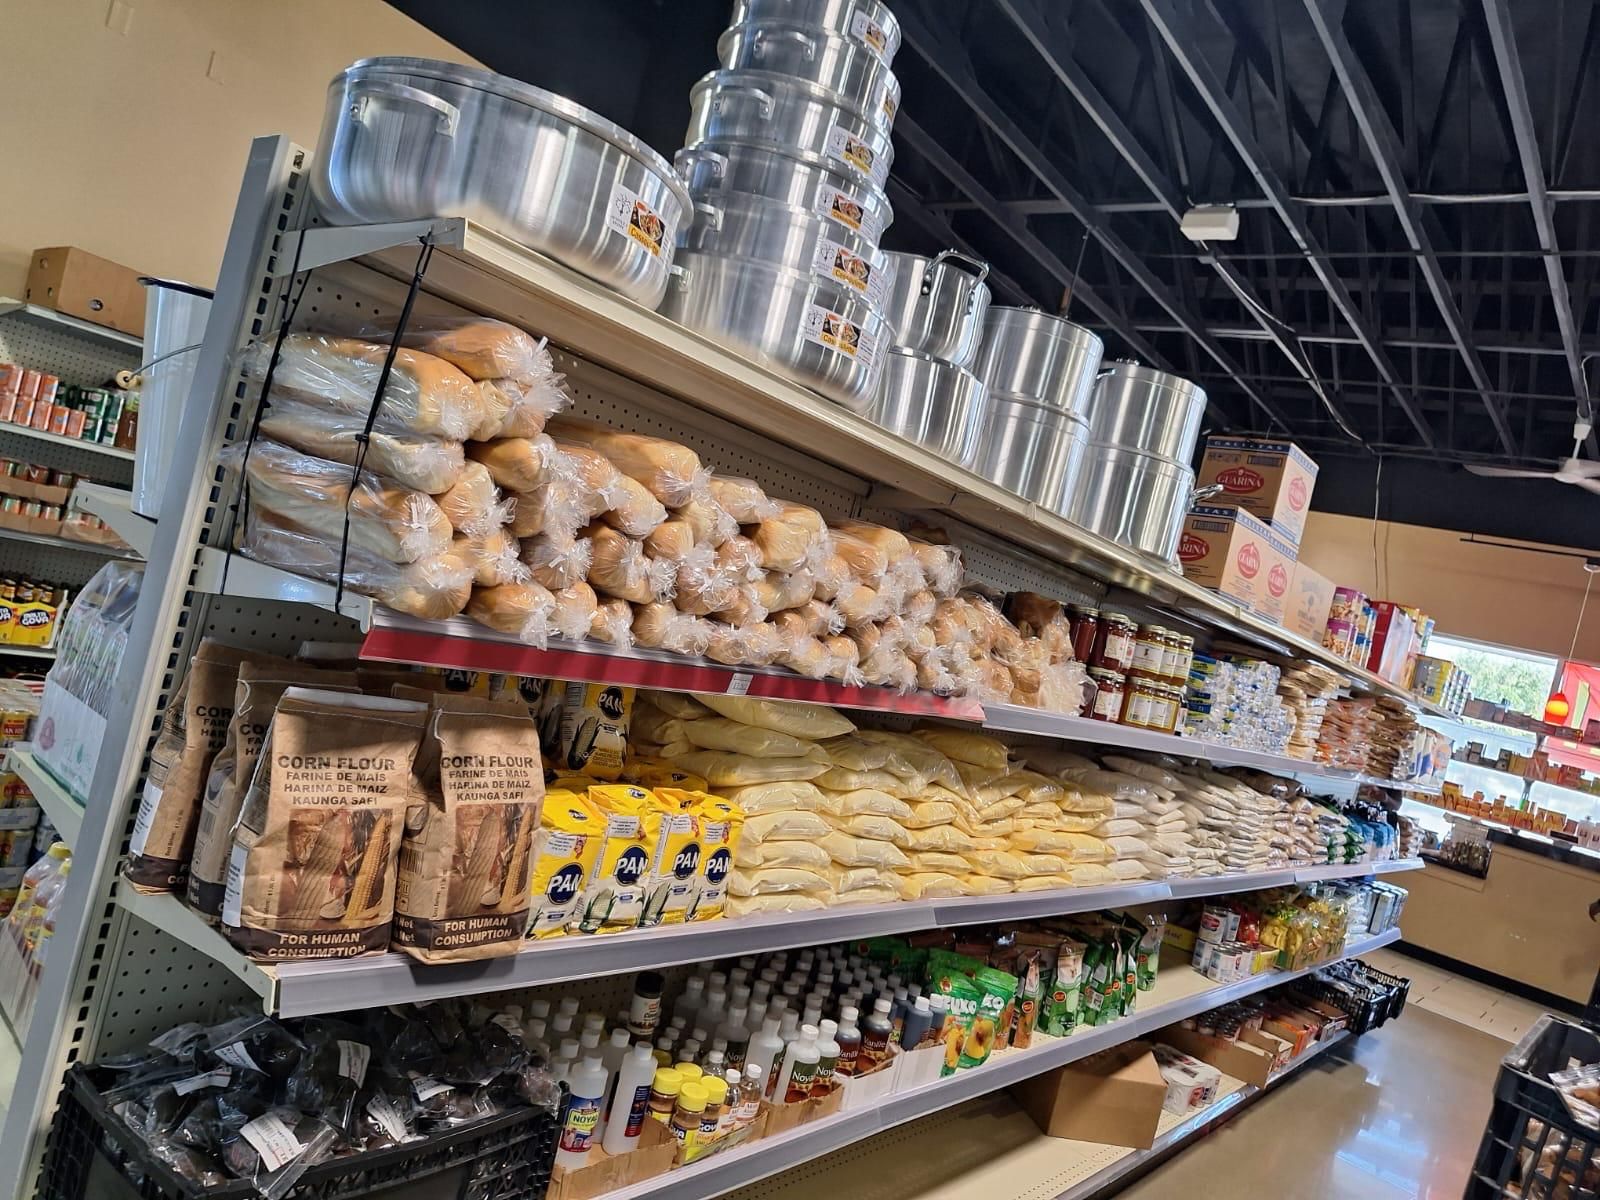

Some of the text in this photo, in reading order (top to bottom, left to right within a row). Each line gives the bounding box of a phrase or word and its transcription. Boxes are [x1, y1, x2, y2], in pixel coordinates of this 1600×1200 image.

[1217, 476, 1261, 489] GUARINA
[598, 692, 625, 714] PAN
[196, 705, 233, 719] COR
[278, 755, 395, 771] CORN FLOUR
[441, 755, 533, 769] CORN FLOUR
[286, 771, 332, 781] FARINE
[337, 772, 353, 781] DE
[449, 770, 486, 778] FARINE
[489, 770, 501, 778] DE
[284, 783, 334, 793] HARINA
[338, 784, 353, 793] DE
[449, 781, 489, 790] HARINA
[492, 781, 505, 789] DE
[292, 796, 377, 805] KAUNGA SAFI
[456, 791, 524, 801] KAUNGA SAFI
[617, 856, 649, 875] PAN
[675, 851, 700, 870] PAN
[705, 856, 732, 873] PAN
[549, 875, 584, 893] PAN
[445, 917, 508, 932] FOR HUMAN
[279, 932, 360, 945] FOR HUMAN
[435, 929, 513, 945] CONSUMPTION
[268, 945, 366, 957] CONSUMPTION
